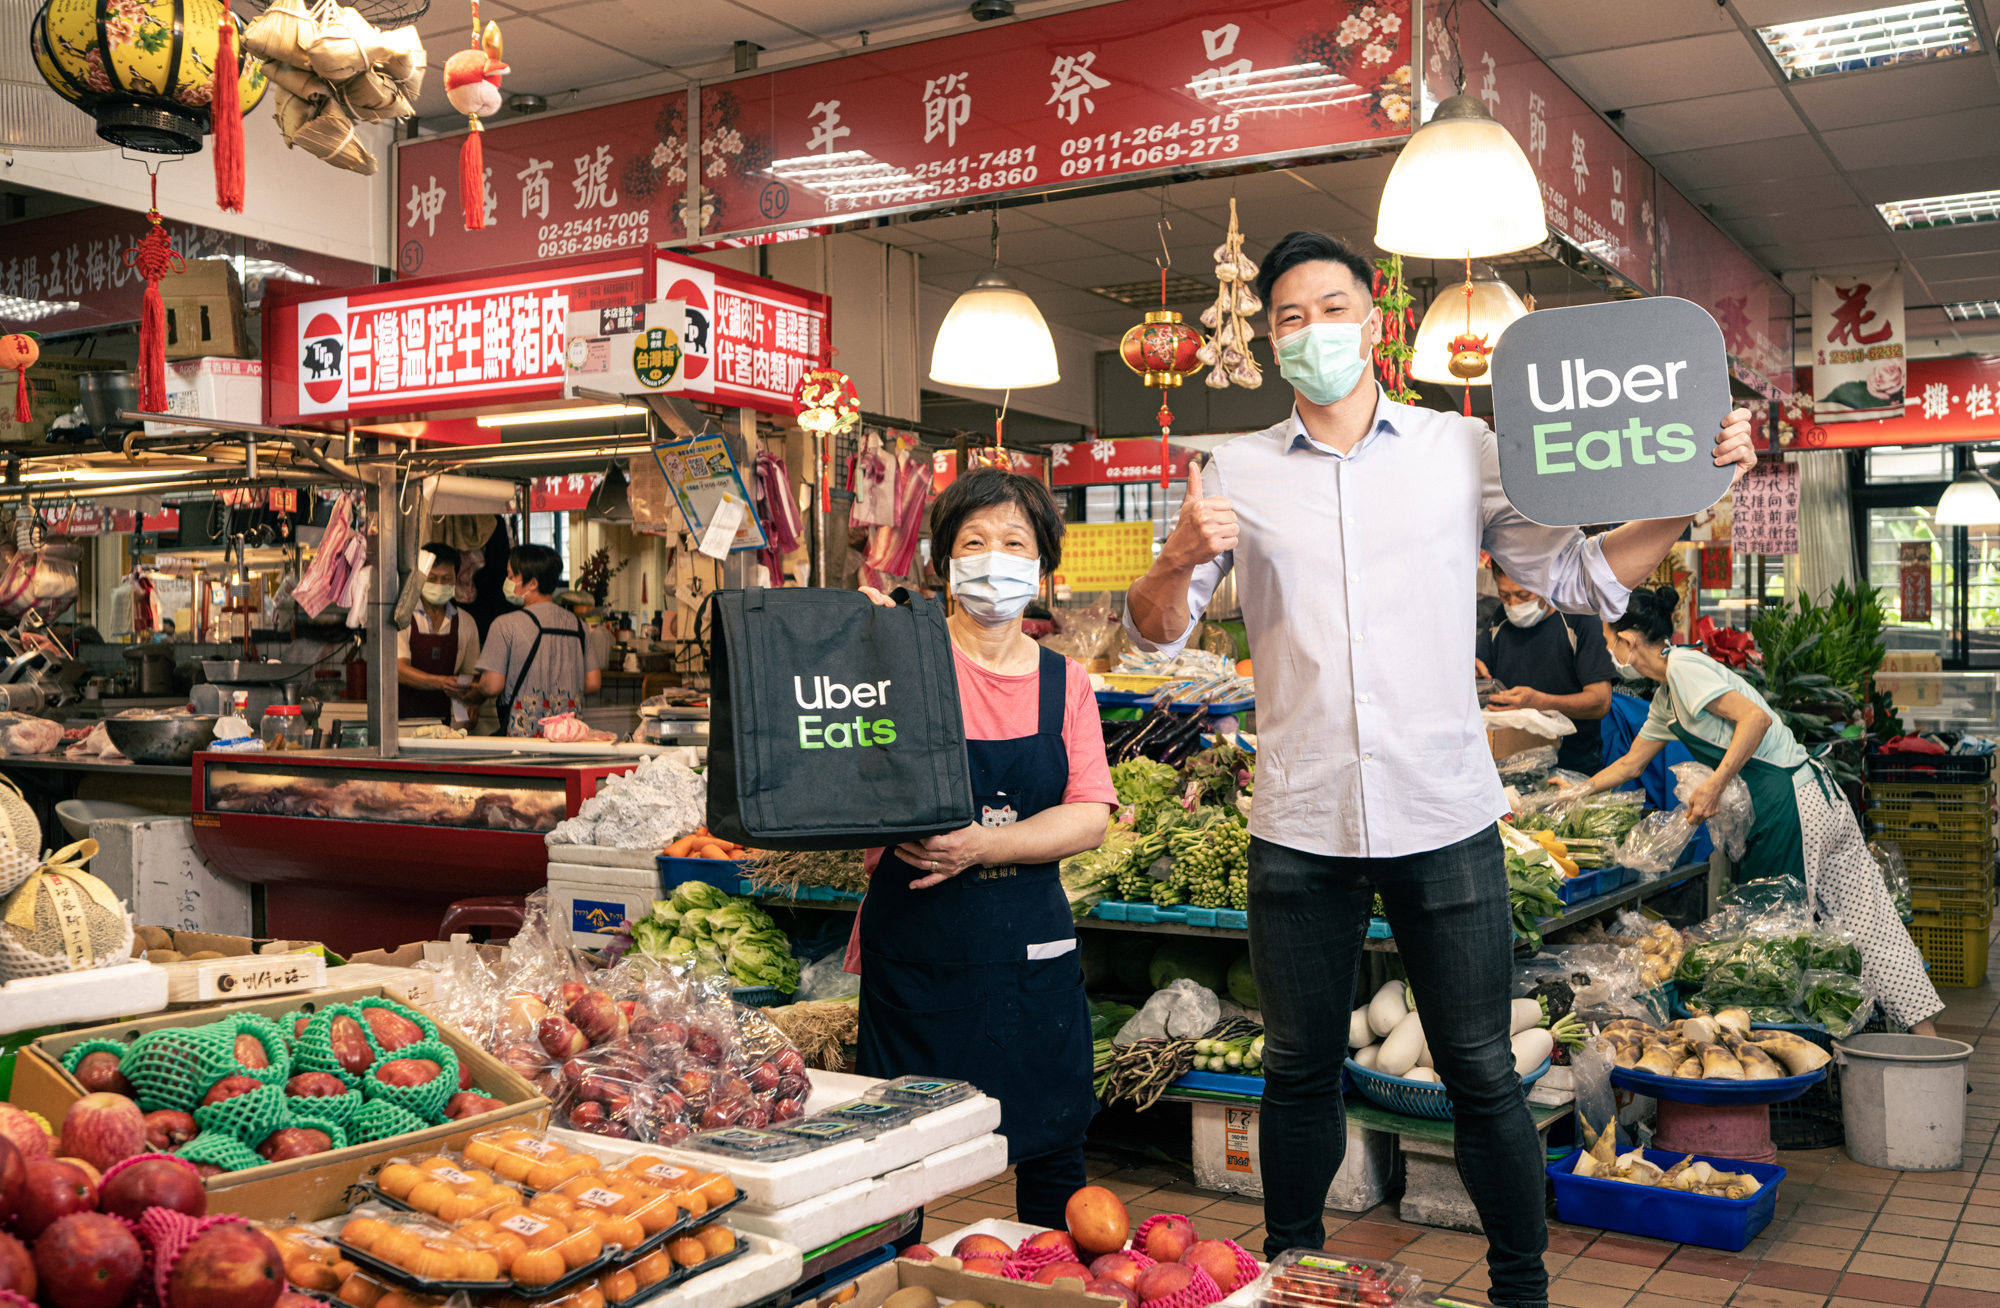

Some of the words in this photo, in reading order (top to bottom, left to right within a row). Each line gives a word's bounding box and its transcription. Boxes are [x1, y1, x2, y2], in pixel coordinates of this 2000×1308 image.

[805, 22, 1253, 167] 年節祭品
[1060, 113, 1240, 157] 0911-264-515
[1480, 50, 1625, 226] 年節祭品
[1060, 133, 1240, 177] 0911-069-273
[764, 188, 785, 212] 50
[538, 209, 650, 242] 02-2541-7006
[404, 249, 421, 267] 51
[538, 227, 650, 259] 0936-296-613
[1827, 283, 1893, 347] 花
[348, 288, 569, 394] 台灣溫控生鮮豬肉
[650, 331, 662, 339] 本店
[650, 340, 662, 348] 使用
[636, 350, 674, 368] 台灣豬
[1829, 343, 1904, 364] 2541-6232
[640, 374, 657, 387] TAIWAN
[657, 373, 671, 386] PORK
[1527, 358, 1688, 413] Uber
[1533, 417, 1698, 476] Eats
[1809, 429, 1825, 443] 30
[1106, 463, 1178, 478] 02-2561-452
[1732, 473, 1751, 554] 頭皮紅燒肉
[794, 675, 892, 710] Uber
[797, 714, 898, 750] Eats
[1227, 1155, 1250, 1167] PPLE
